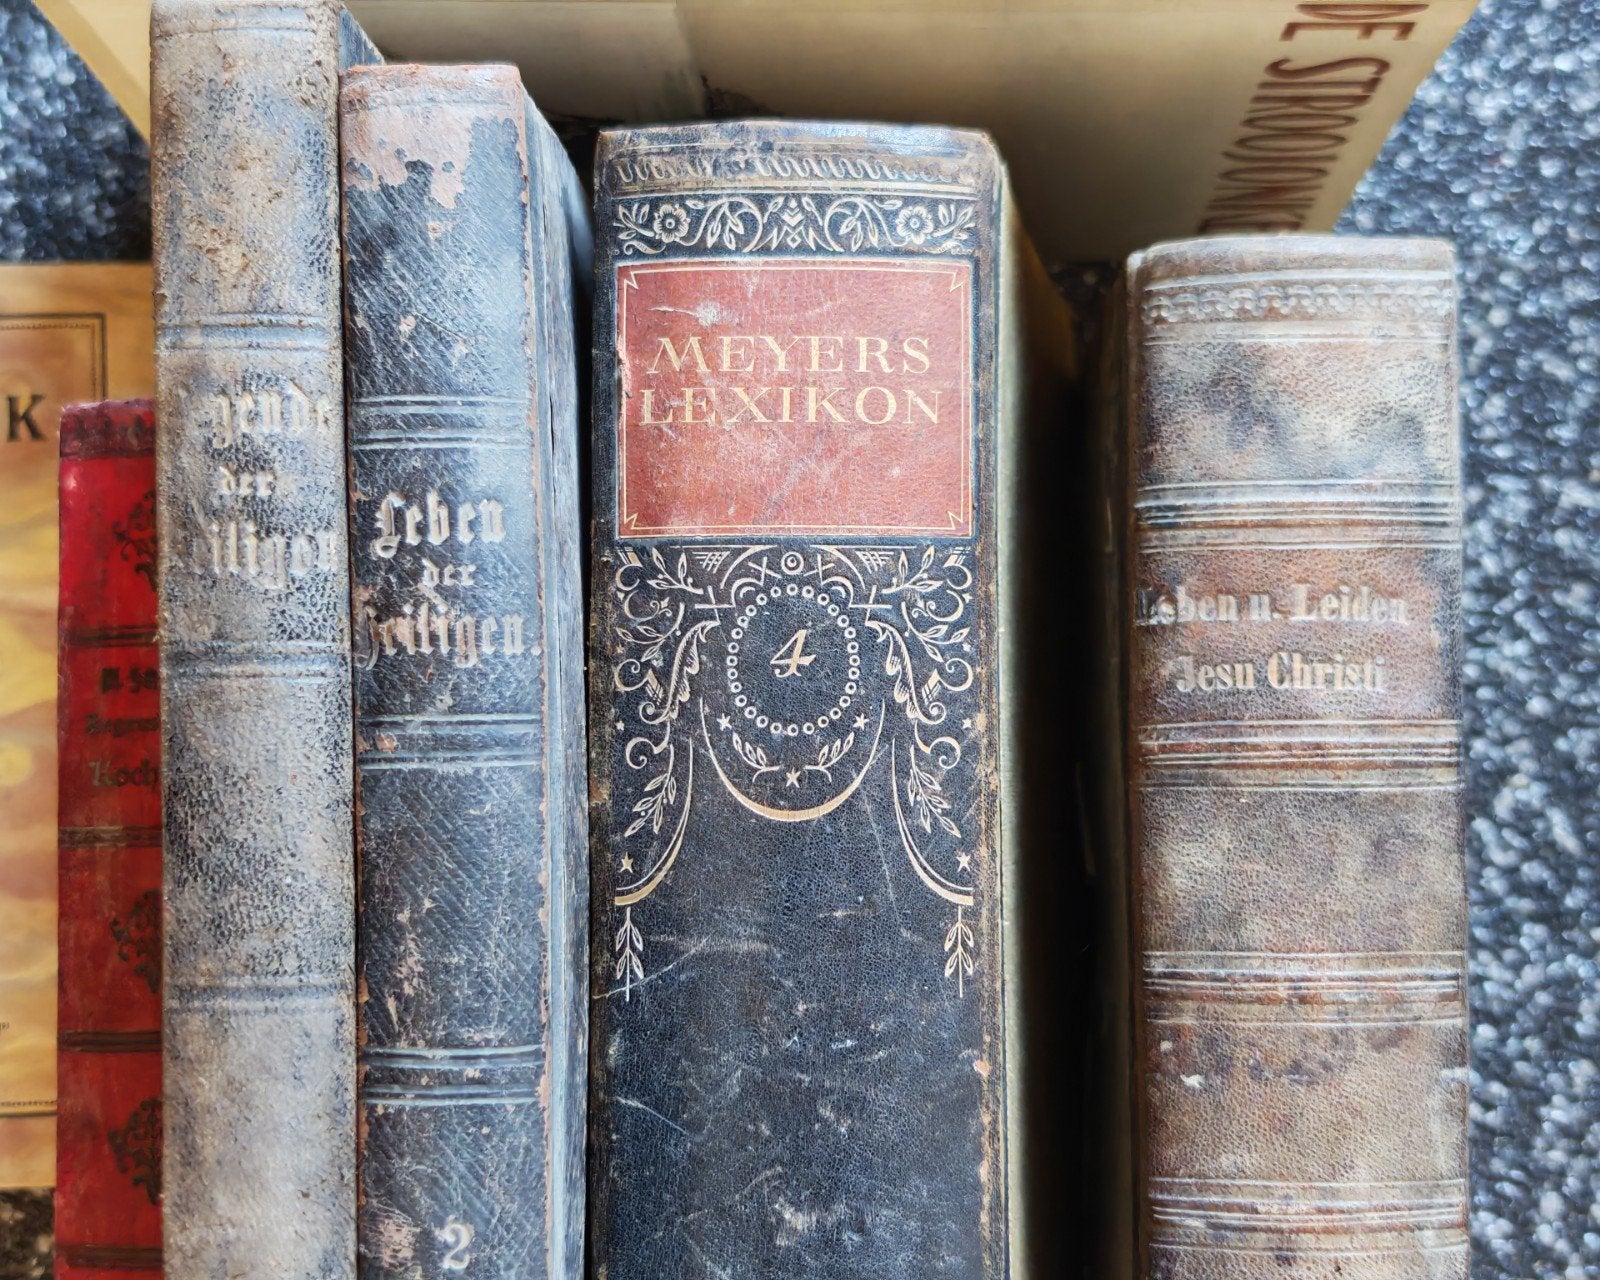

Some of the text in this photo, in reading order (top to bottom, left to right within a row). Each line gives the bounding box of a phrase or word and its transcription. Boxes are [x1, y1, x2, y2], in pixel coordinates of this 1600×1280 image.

[1279, 3, 1429, 42] DE
[646, 336, 931, 374] MEYERS
[196, 379, 335, 449] gende
[640, 386, 942, 425] LEXIKON
[219, 465, 274, 496] der
[370, 490, 506, 558] Leben
[200, 521, 337, 589] iligen
[422, 557, 476, 586] der
[1135, 584, 1240, 626] Leben
[1288, 583, 1409, 625] Leiden
[769, 629, 817, 678] 4
[1175, 651, 1386, 692] Jesu Christi
[436, 1217, 475, 1270] 2
